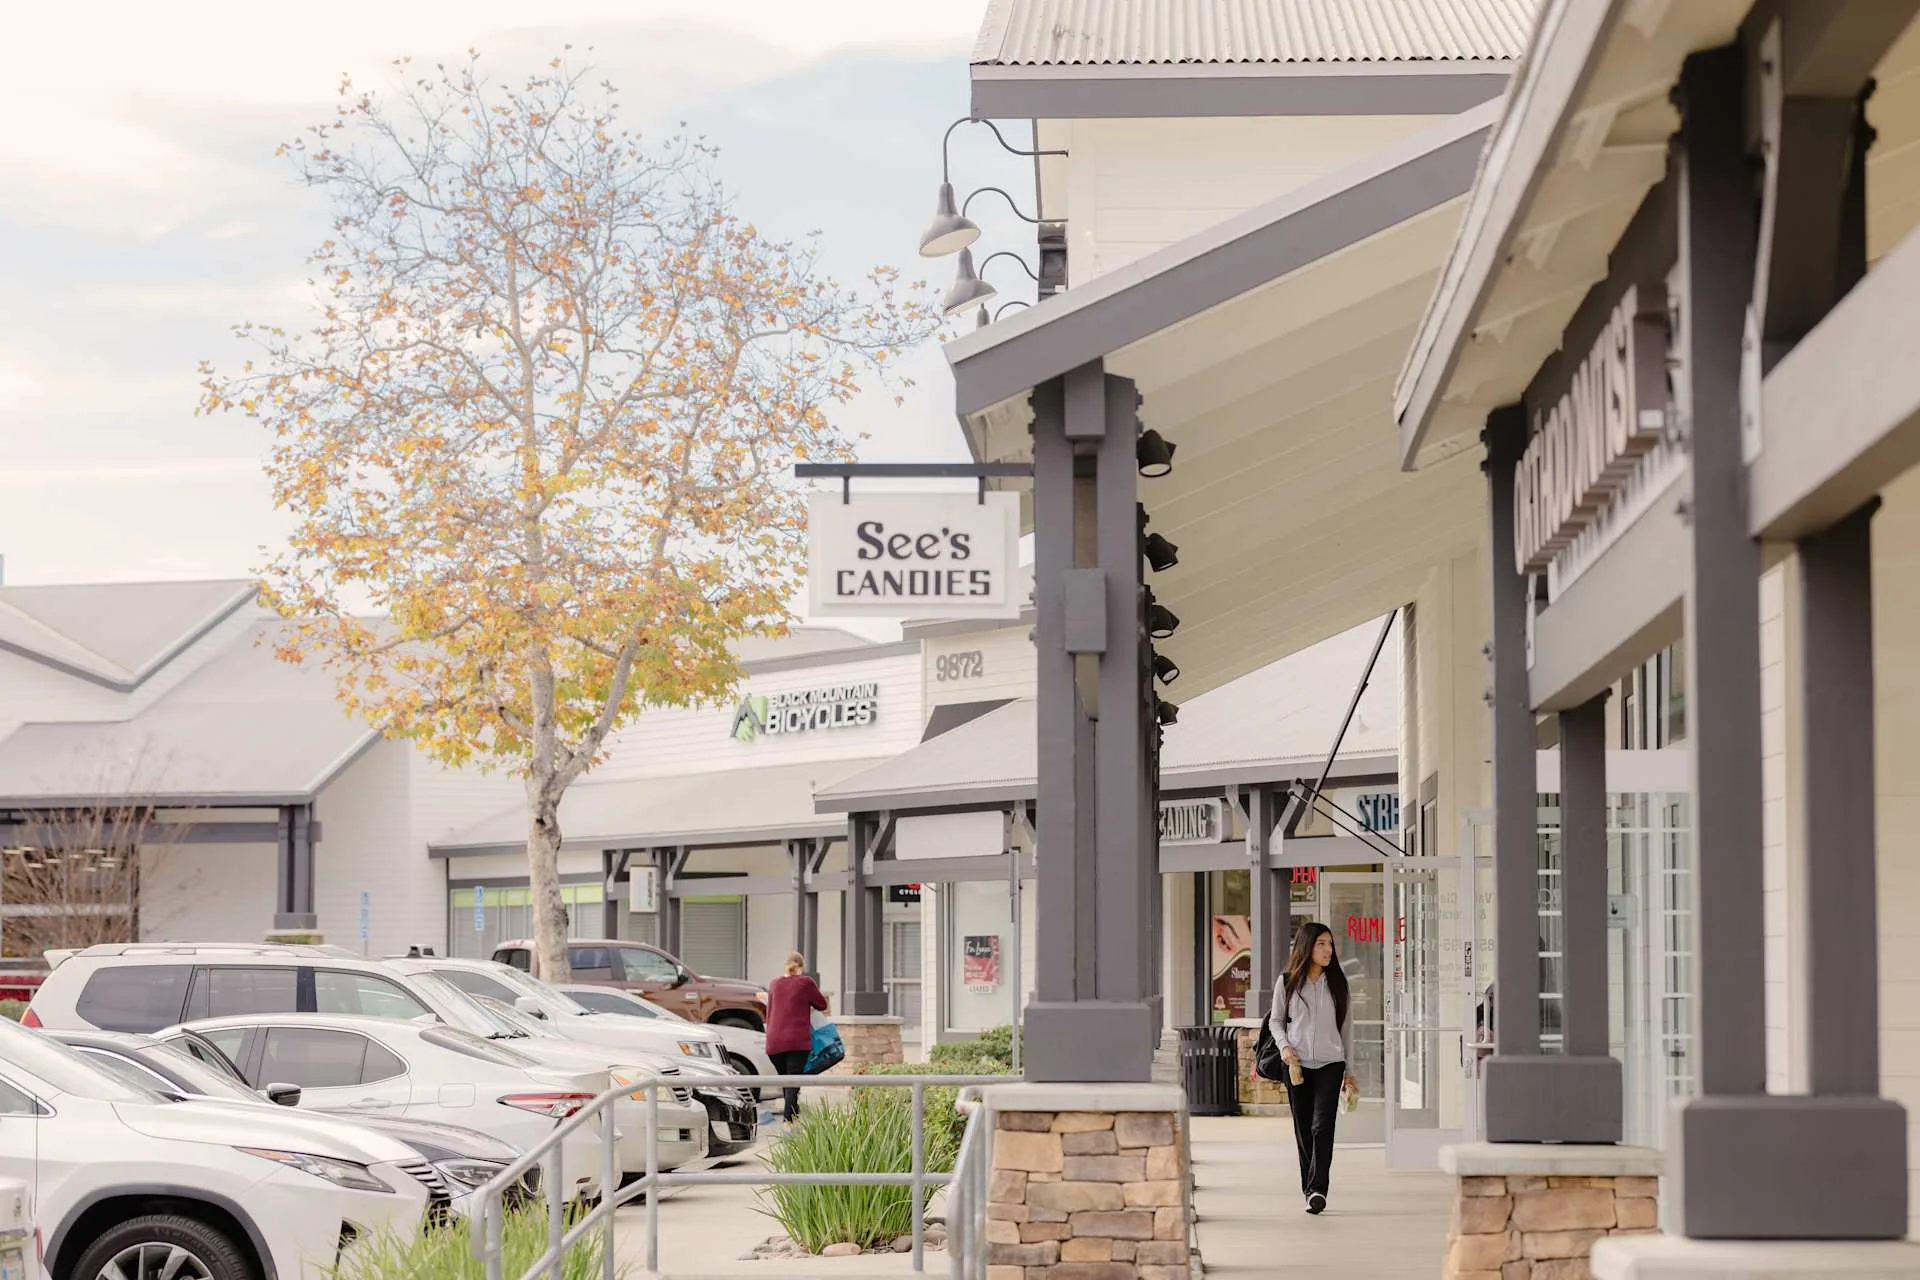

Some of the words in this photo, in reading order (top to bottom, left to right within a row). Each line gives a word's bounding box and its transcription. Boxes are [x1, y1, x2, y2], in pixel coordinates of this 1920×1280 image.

[857, 521, 971, 560] See's
[836, 569, 991, 596] CANDIES
[936, 650, 983, 682] 9872
[771, 691, 810, 708] BLACK
[810, 683, 877, 705] MOUNTAIN
[766, 700, 877, 734] BICYCLES
